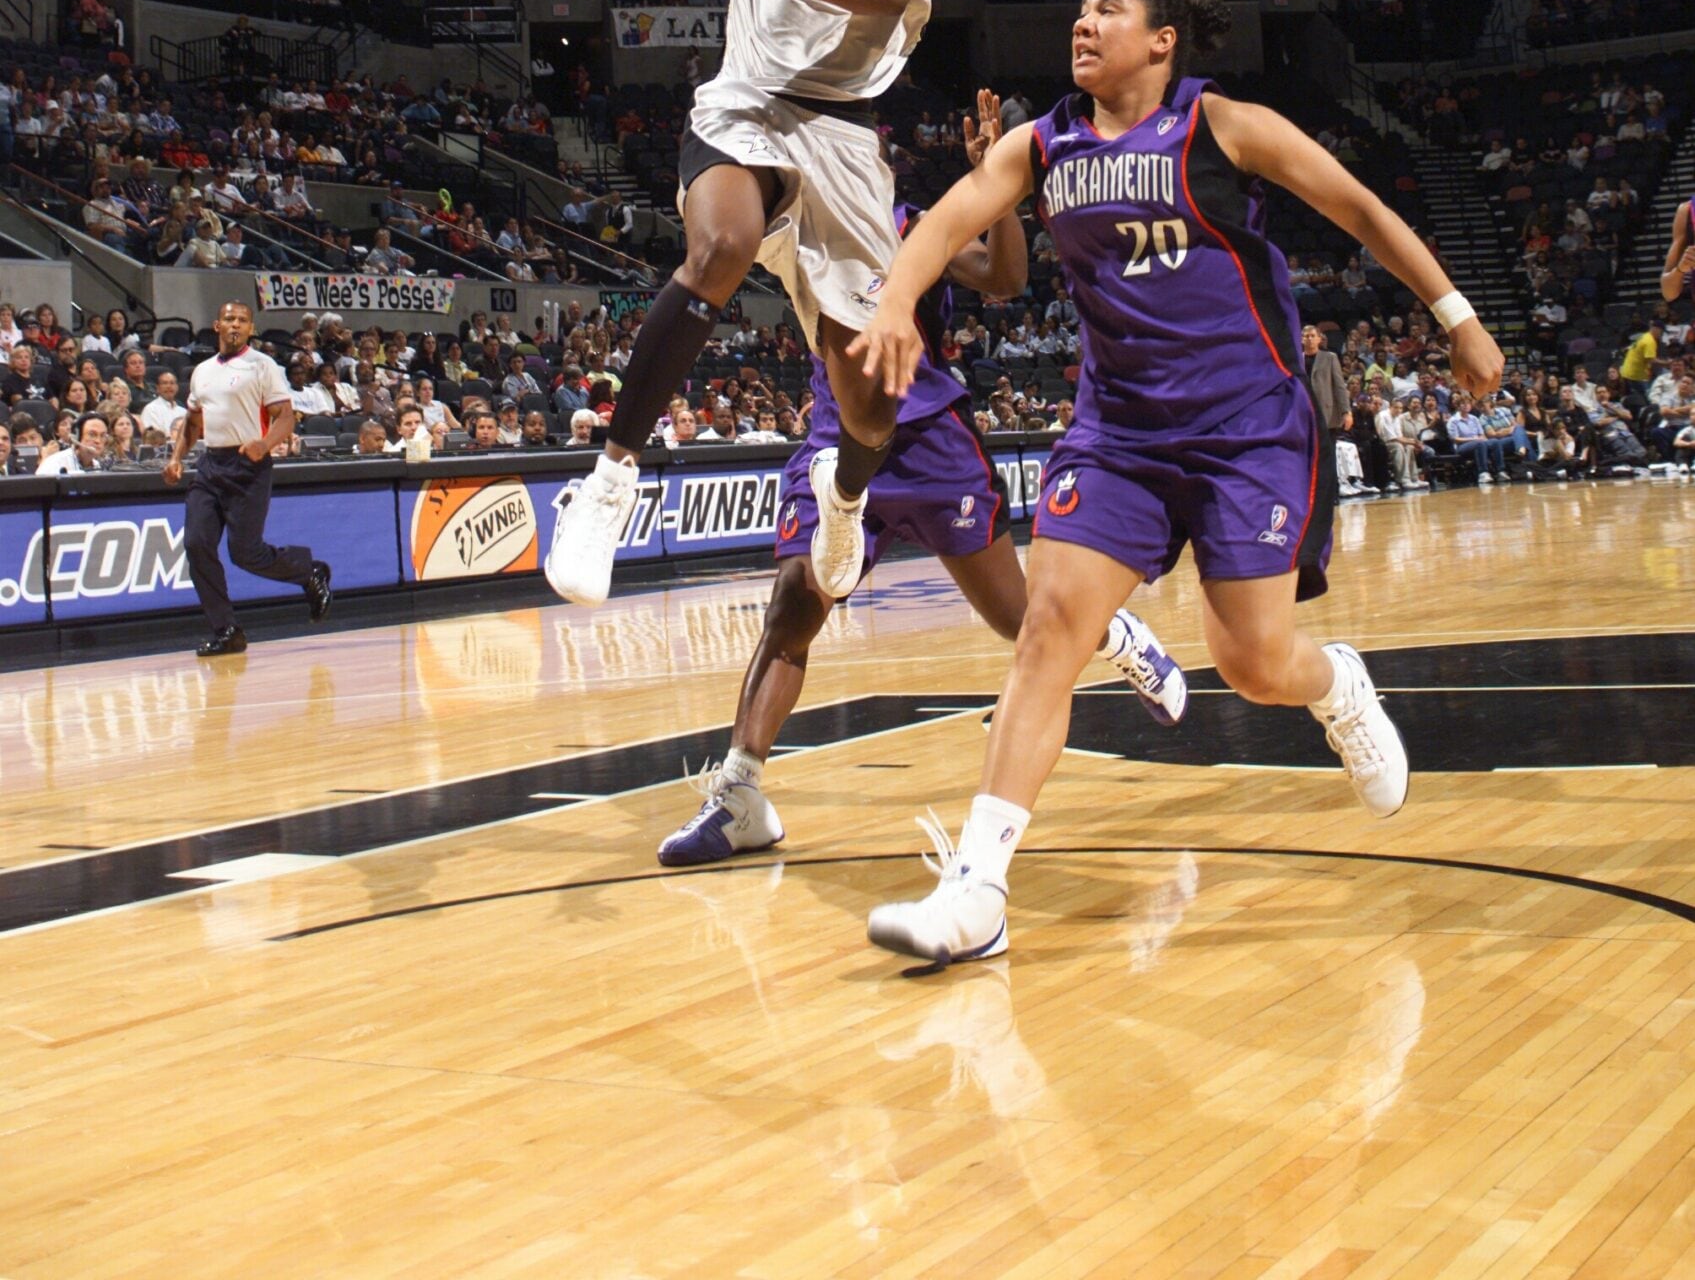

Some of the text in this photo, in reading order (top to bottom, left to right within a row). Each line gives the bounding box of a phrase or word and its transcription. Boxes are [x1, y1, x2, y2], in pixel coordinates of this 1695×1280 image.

[1043, 153, 1175, 218] SACRAMENTO
[1114, 218, 1188, 277] 20
[271, 275, 435, 310] Pee Wee's Posse
[493, 289, 515, 308] 10
[475, 498, 526, 545] WNBA
